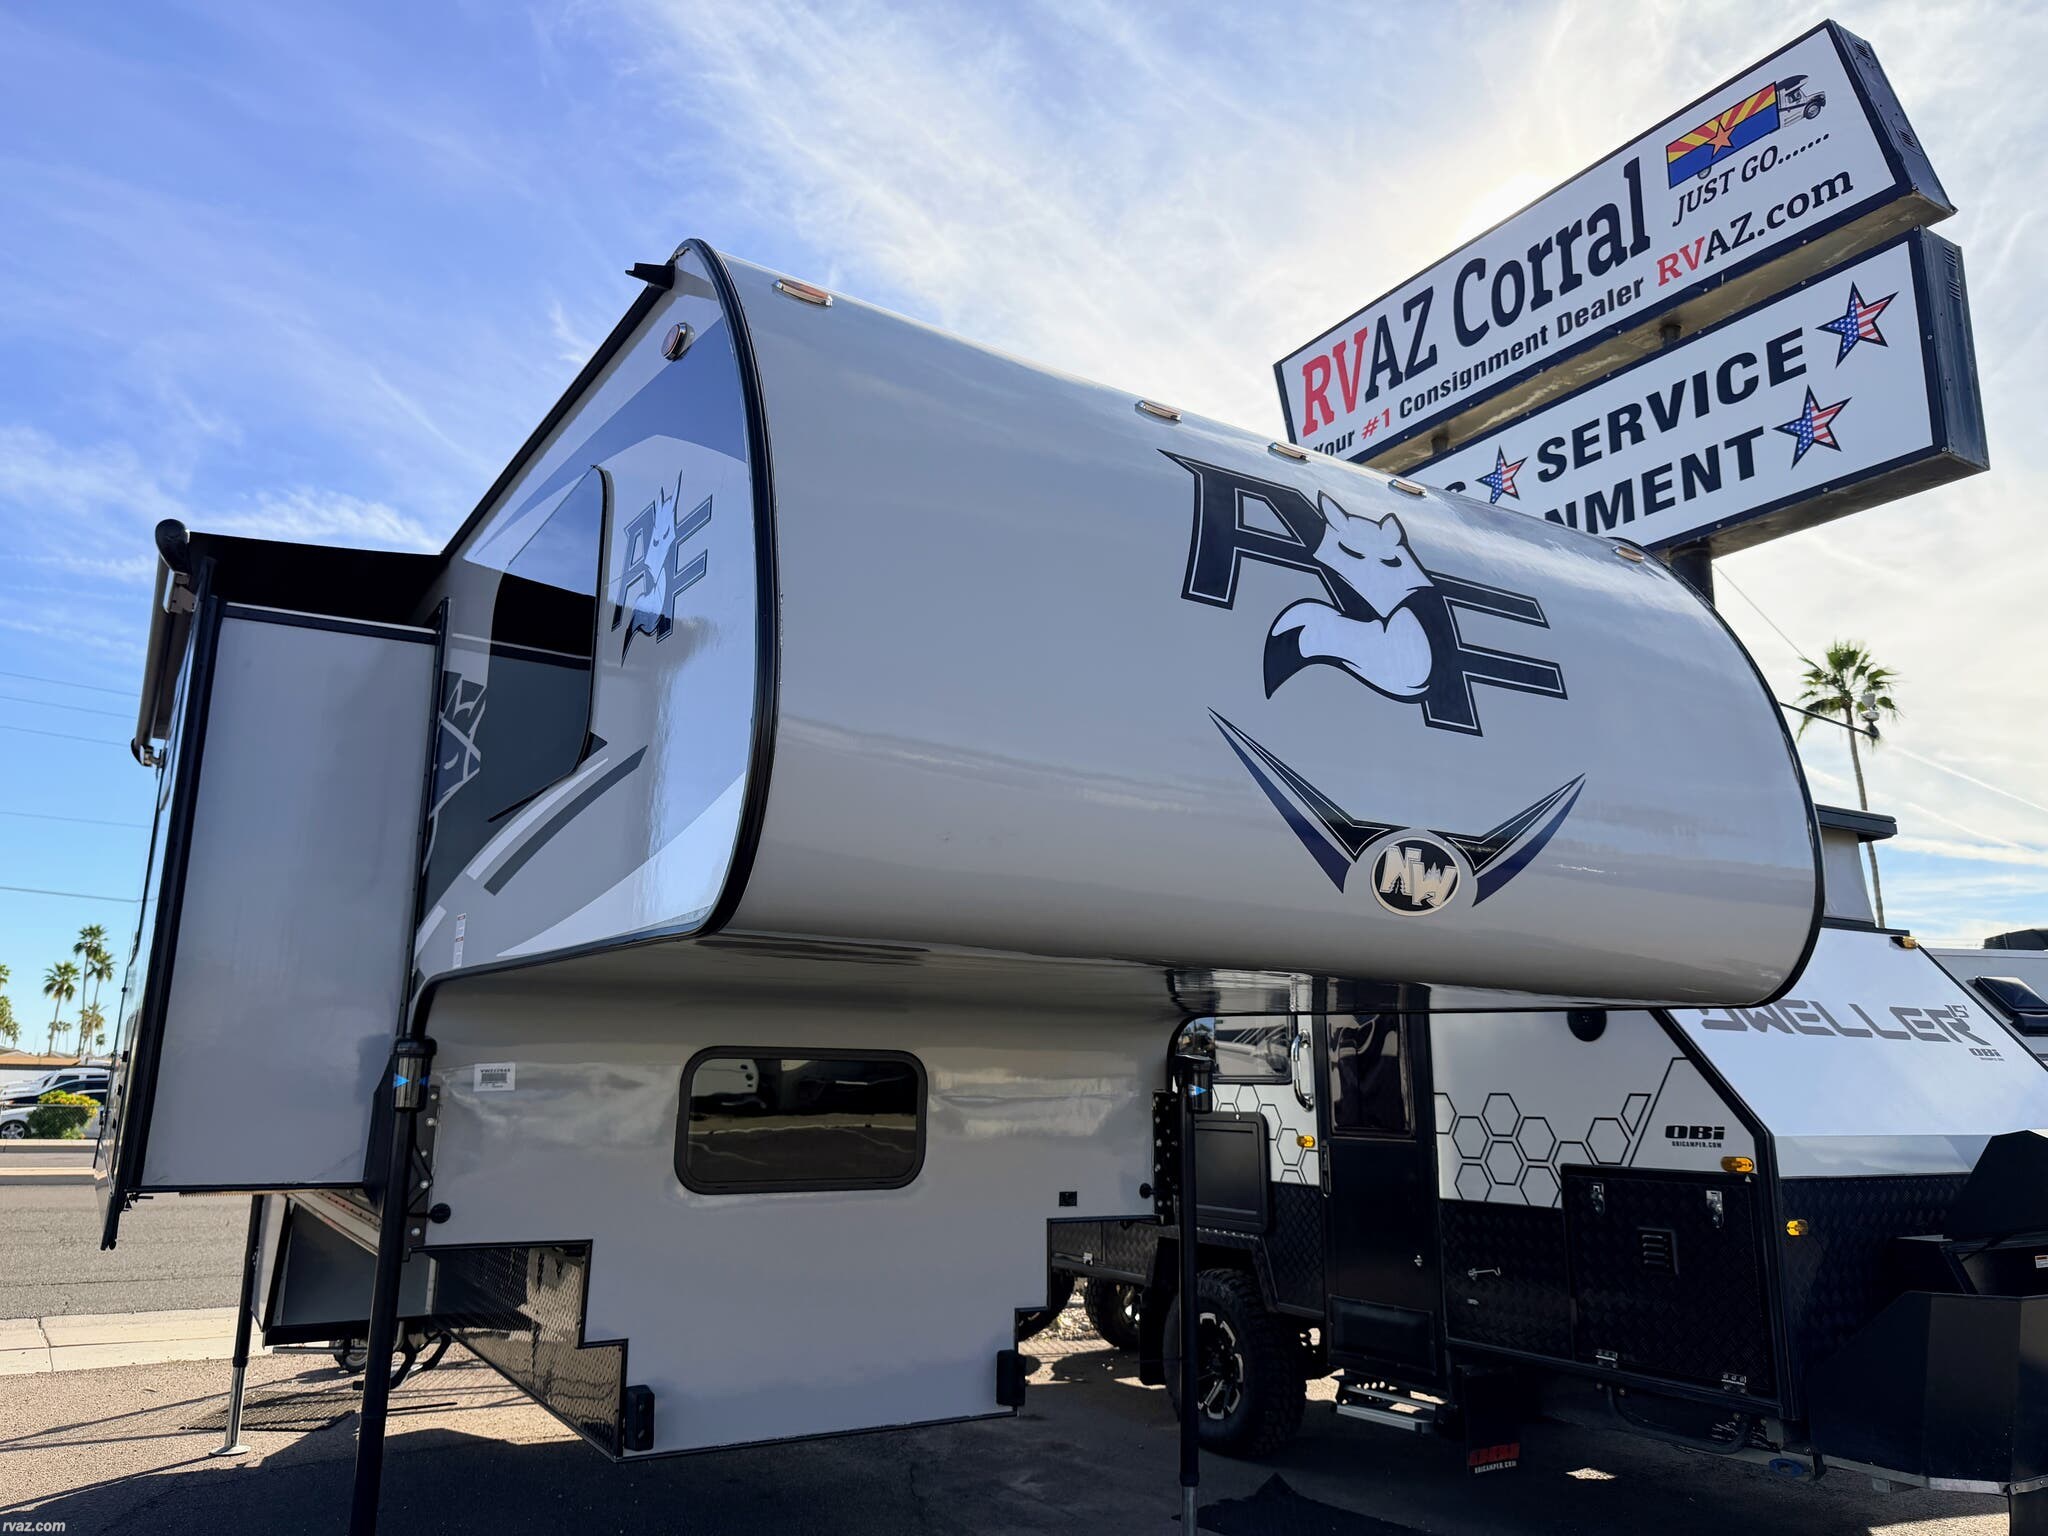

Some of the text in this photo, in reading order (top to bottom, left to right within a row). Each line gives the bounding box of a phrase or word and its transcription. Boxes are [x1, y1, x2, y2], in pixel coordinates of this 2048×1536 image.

[1672, 168, 1735, 227] JUST
[1302, 156, 1651, 437] RVAZ Corral
[1361, 408, 1390, 440] #1
[1400, 325, 1548, 419] Consignment
[1556, 277, 1644, 338] Dealer
[1656, 171, 1854, 287] RVAZ.com
[1537, 327, 1808, 483] SERVICE
[1380, 845, 1457, 908] NW
